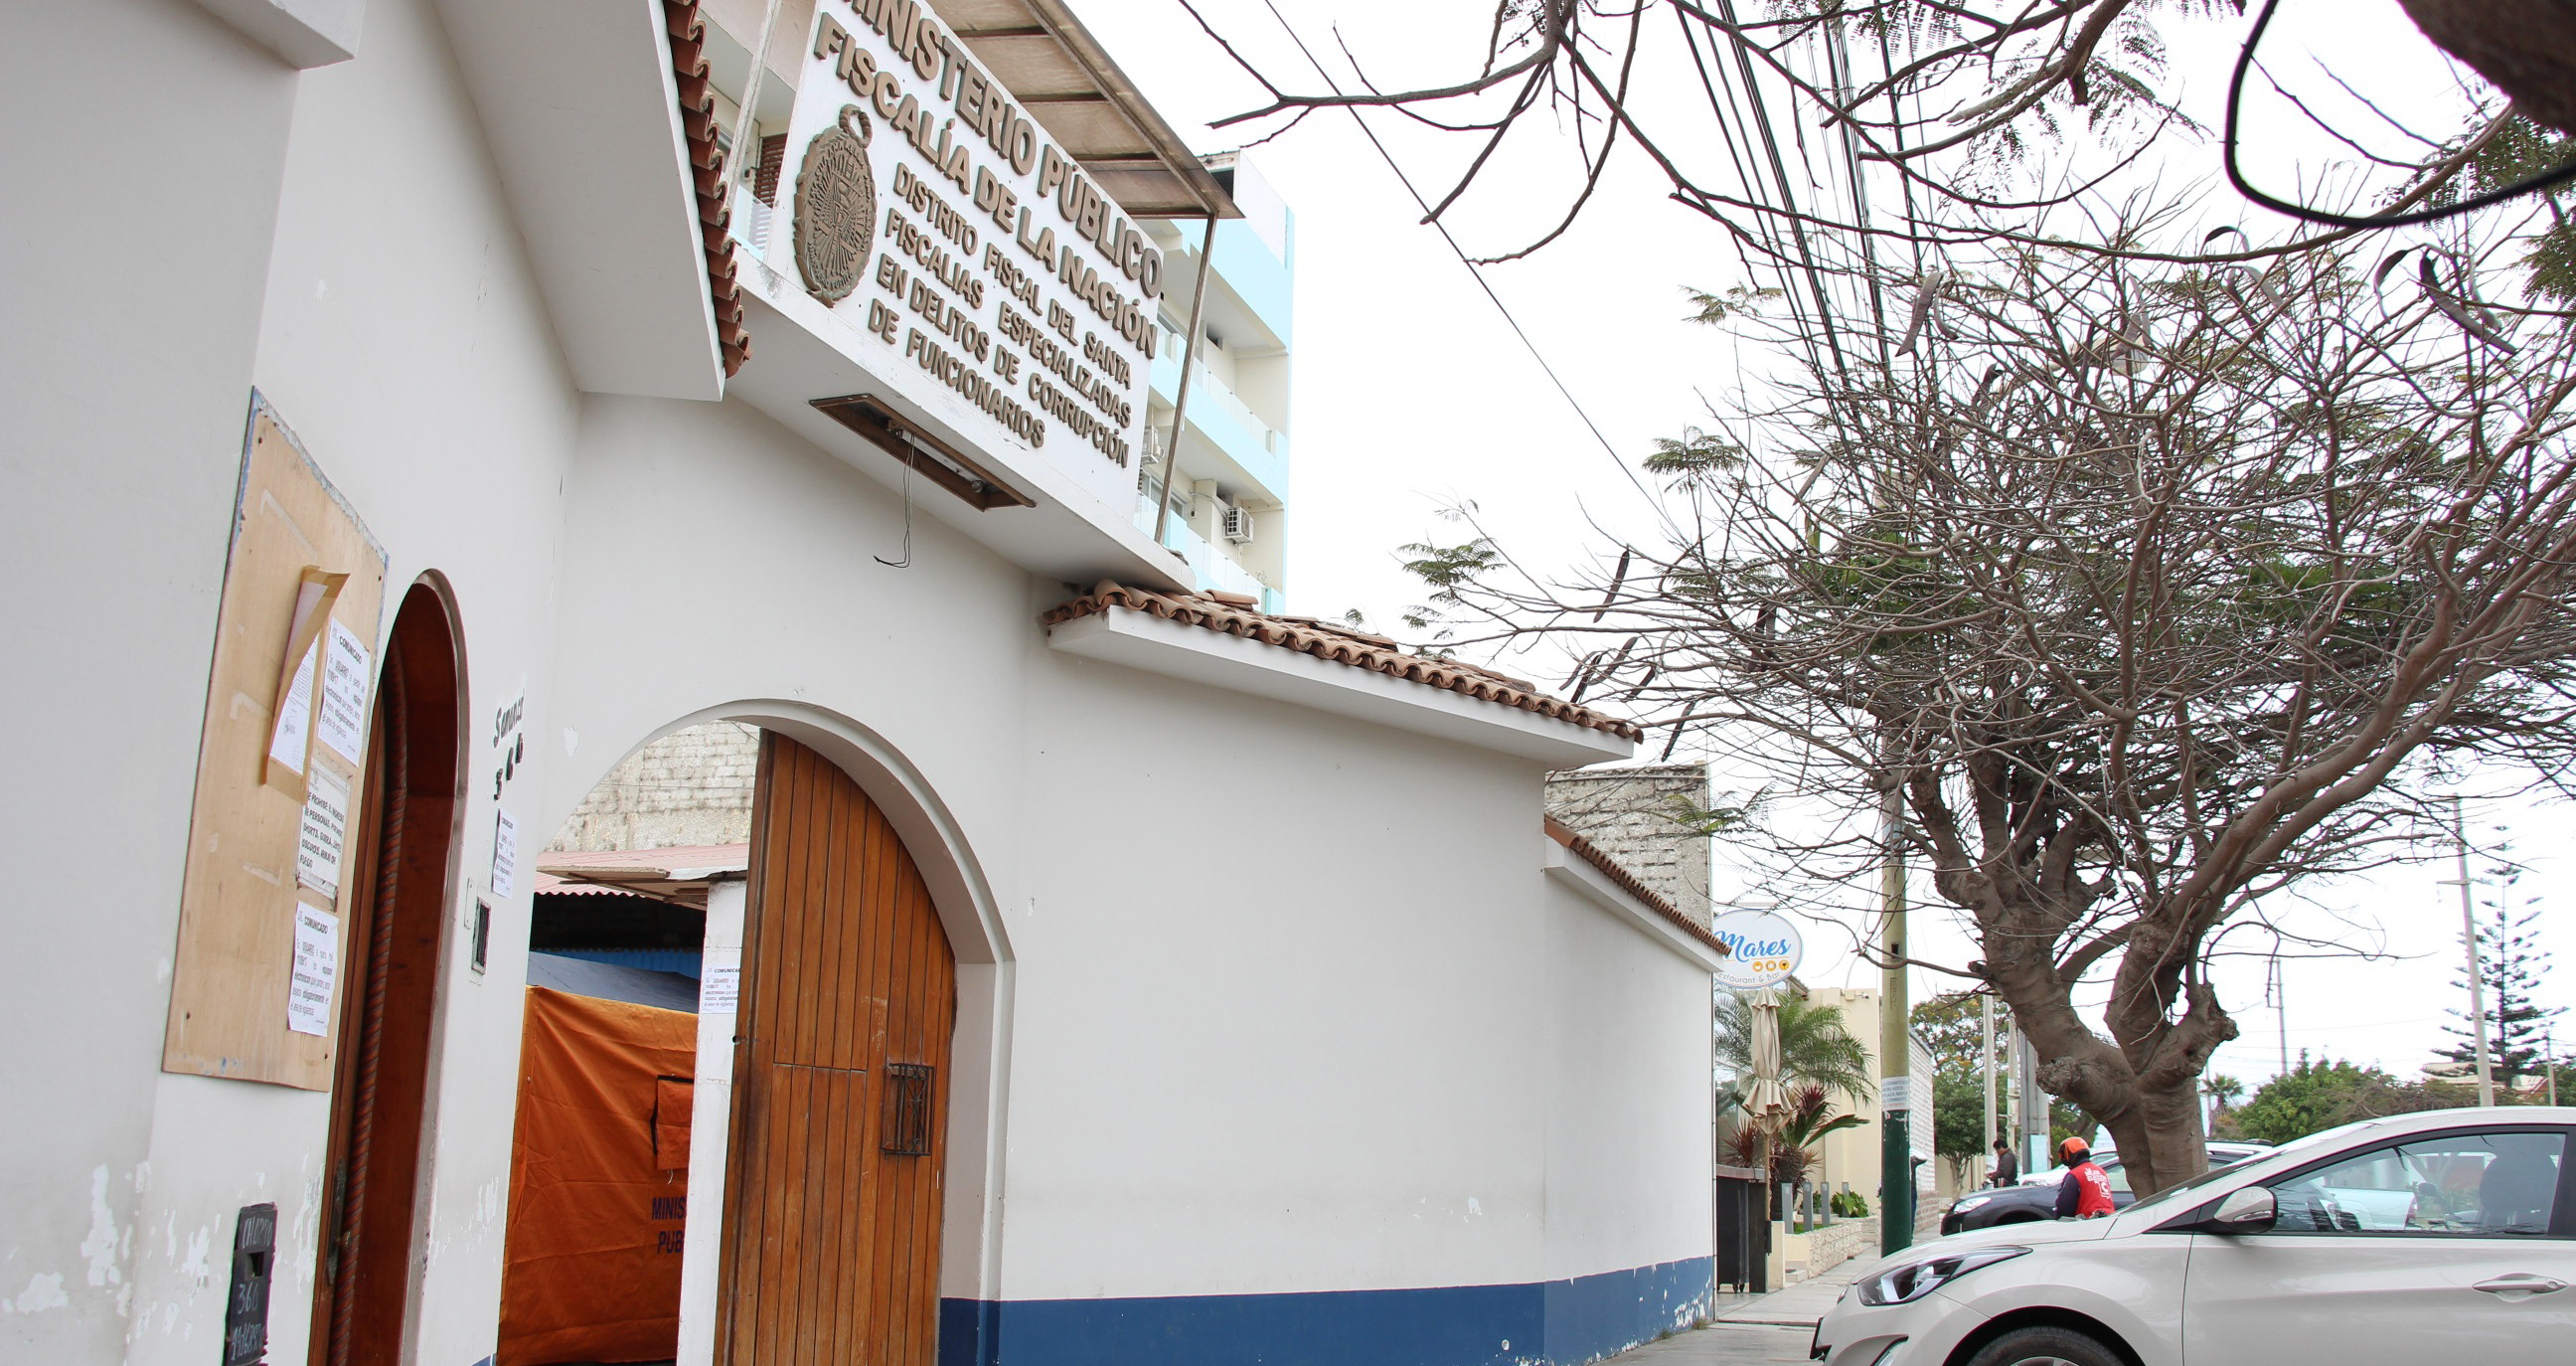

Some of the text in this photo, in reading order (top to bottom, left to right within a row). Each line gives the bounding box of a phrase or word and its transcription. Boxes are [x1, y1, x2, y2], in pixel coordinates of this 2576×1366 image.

[815, 12, 971, 196] FISCALÍA
[974, 164, 1018, 234] DE
[1017, 206, 1056, 273] LA
[1059, 245, 1159, 360] NACIÓN
[842, 0, 1164, 298] NISTERIO PÚBLICO
[885, 207, 985, 309] FISCALIAS
[998, 300, 1132, 429] ESPECIALIZADAS
[892, 162, 979, 256] DISTRITO
[984, 243, 1044, 316] FISCAL
[1046, 298, 1079, 346] DEL
[1083, 330, 1132, 390] SANTA
[868, 298, 1046, 448] DE FUNCIONARIOS
[877, 253, 908, 300] EN
[909, 276, 990, 363] DELITOS
[994, 344, 1020, 386] DE
[1028, 372, 1130, 468] CORRUPCIÓN
[339, 635, 363, 665] COMUNICADO
[304, 916, 329, 935] COMUNICADO
[1713, 931, 1791, 962] Mares
[1716, 972, 1756, 984] estaurant
[1766, 972, 1780, 981] Bar
[238, 1282, 259, 1315] 360
